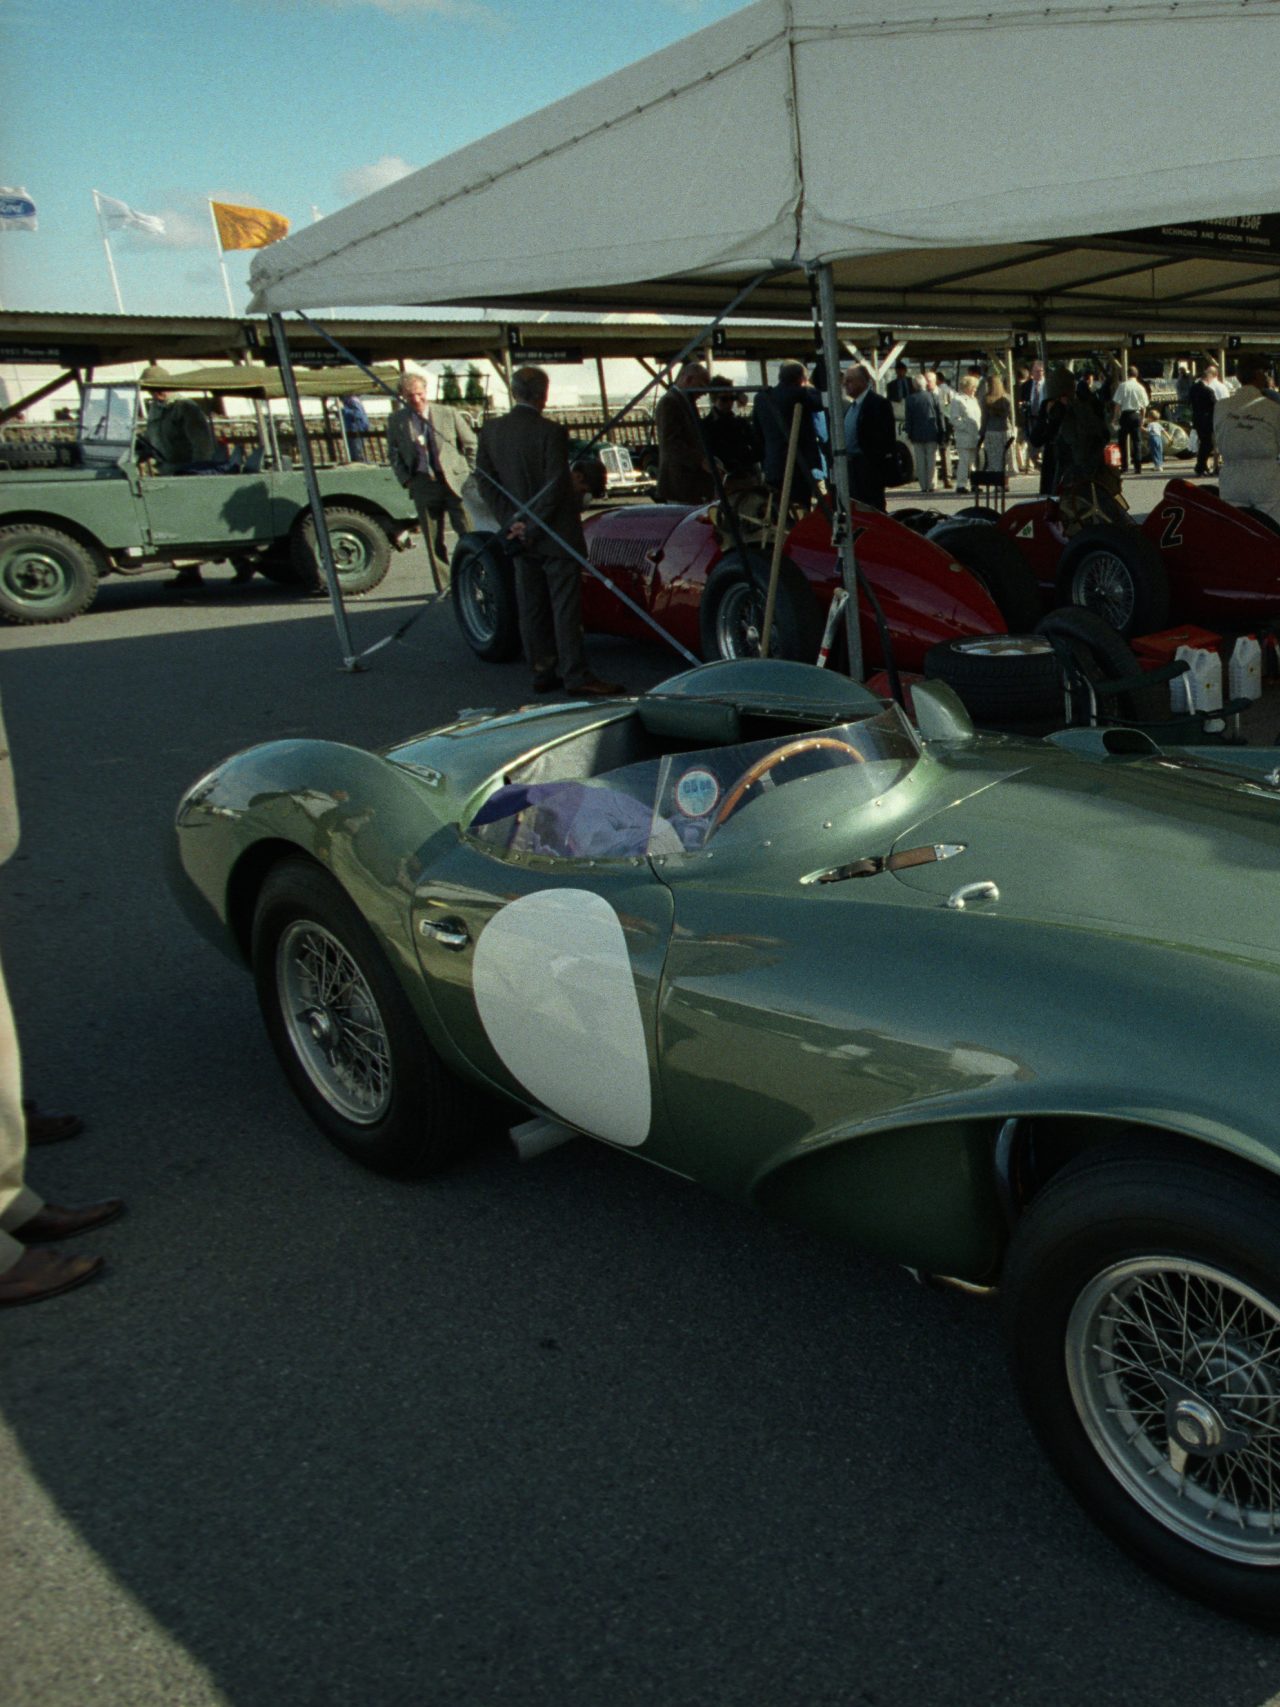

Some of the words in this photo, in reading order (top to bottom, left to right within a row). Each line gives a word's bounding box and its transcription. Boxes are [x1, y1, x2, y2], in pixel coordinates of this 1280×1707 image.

[1240, 216, 1263, 231] 250F
[1161, 227, 1198, 238] RICHMOND
[1201, 231, 1215, 240] AND
[1217, 233, 1243, 242] GORDON
[1160, 506, 1185, 548] 2
